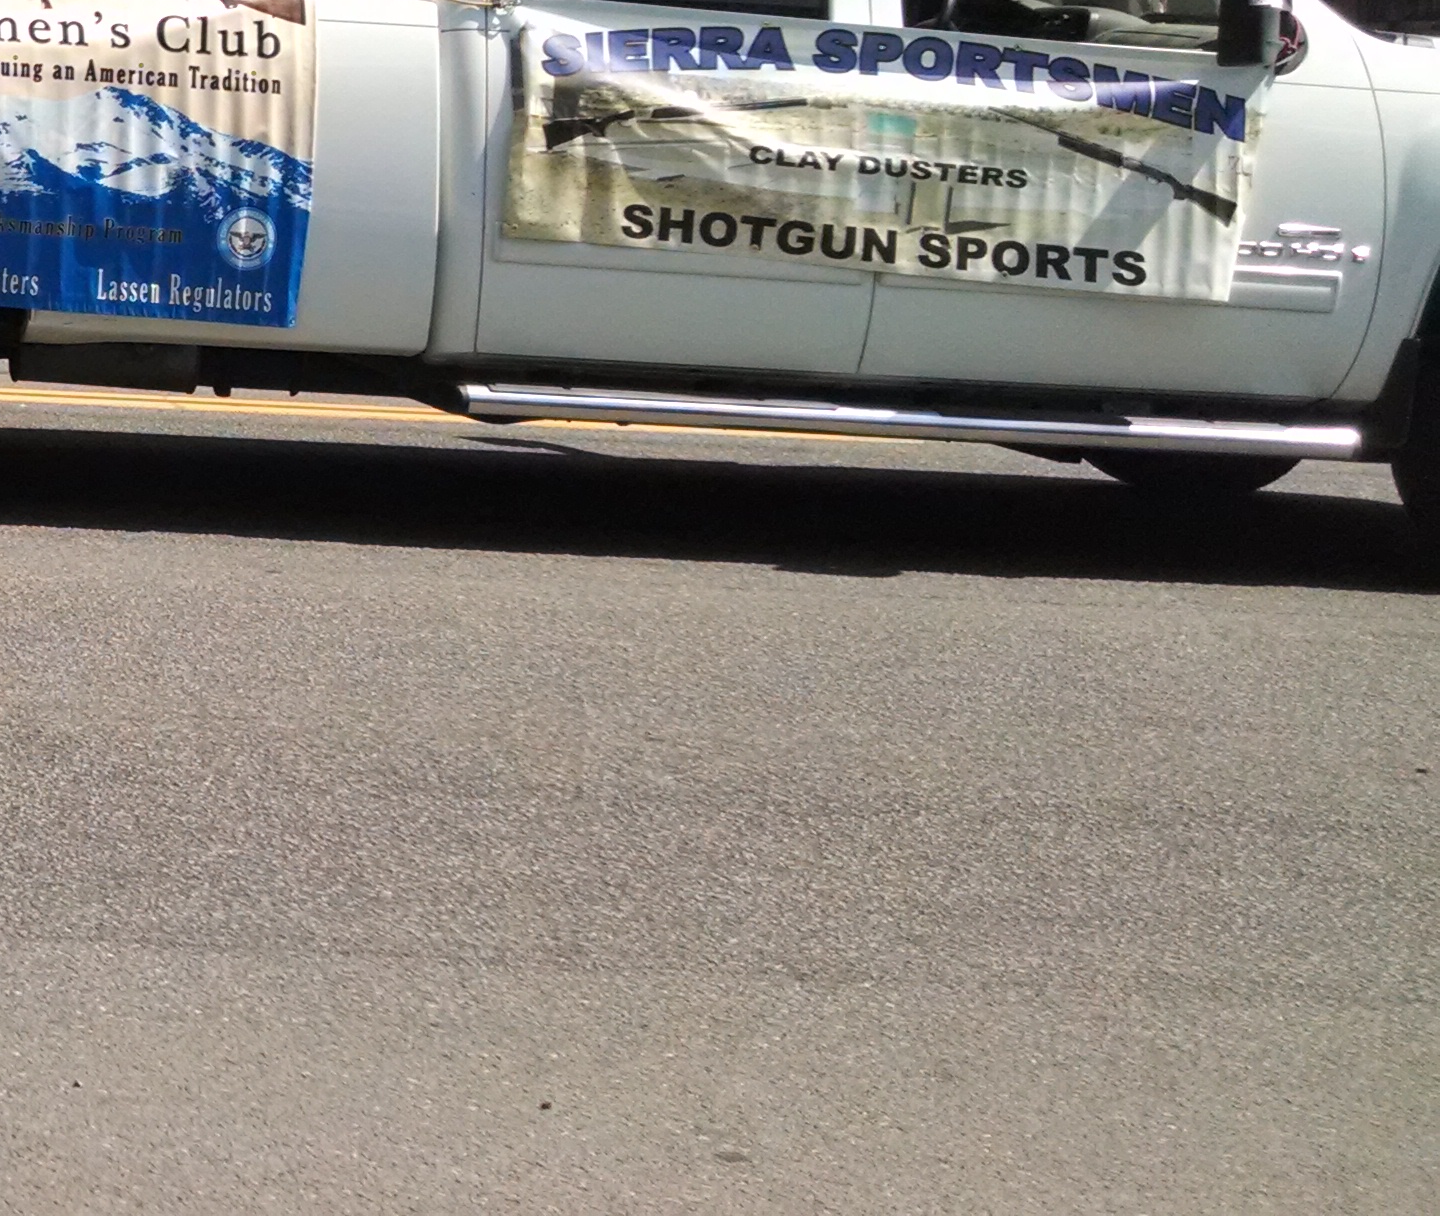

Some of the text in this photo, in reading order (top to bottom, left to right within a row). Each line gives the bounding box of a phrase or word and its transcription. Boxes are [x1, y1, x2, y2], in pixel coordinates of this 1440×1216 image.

[157, 15, 281, 60] Club
[53, 63, 75, 81] an
[84, 59, 178, 88] American
[189, 66, 281, 95] Tradition
[542, 26, 1246, 143] SIERRA SPORTSMEN
[749, 145, 1028, 189] CLAY DUSTERS
[105, 218, 183, 245] Program
[621, 204, 1147, 286] SHOTGUN SPORTS
[97, 269, 272, 313] Lassen Regulators
